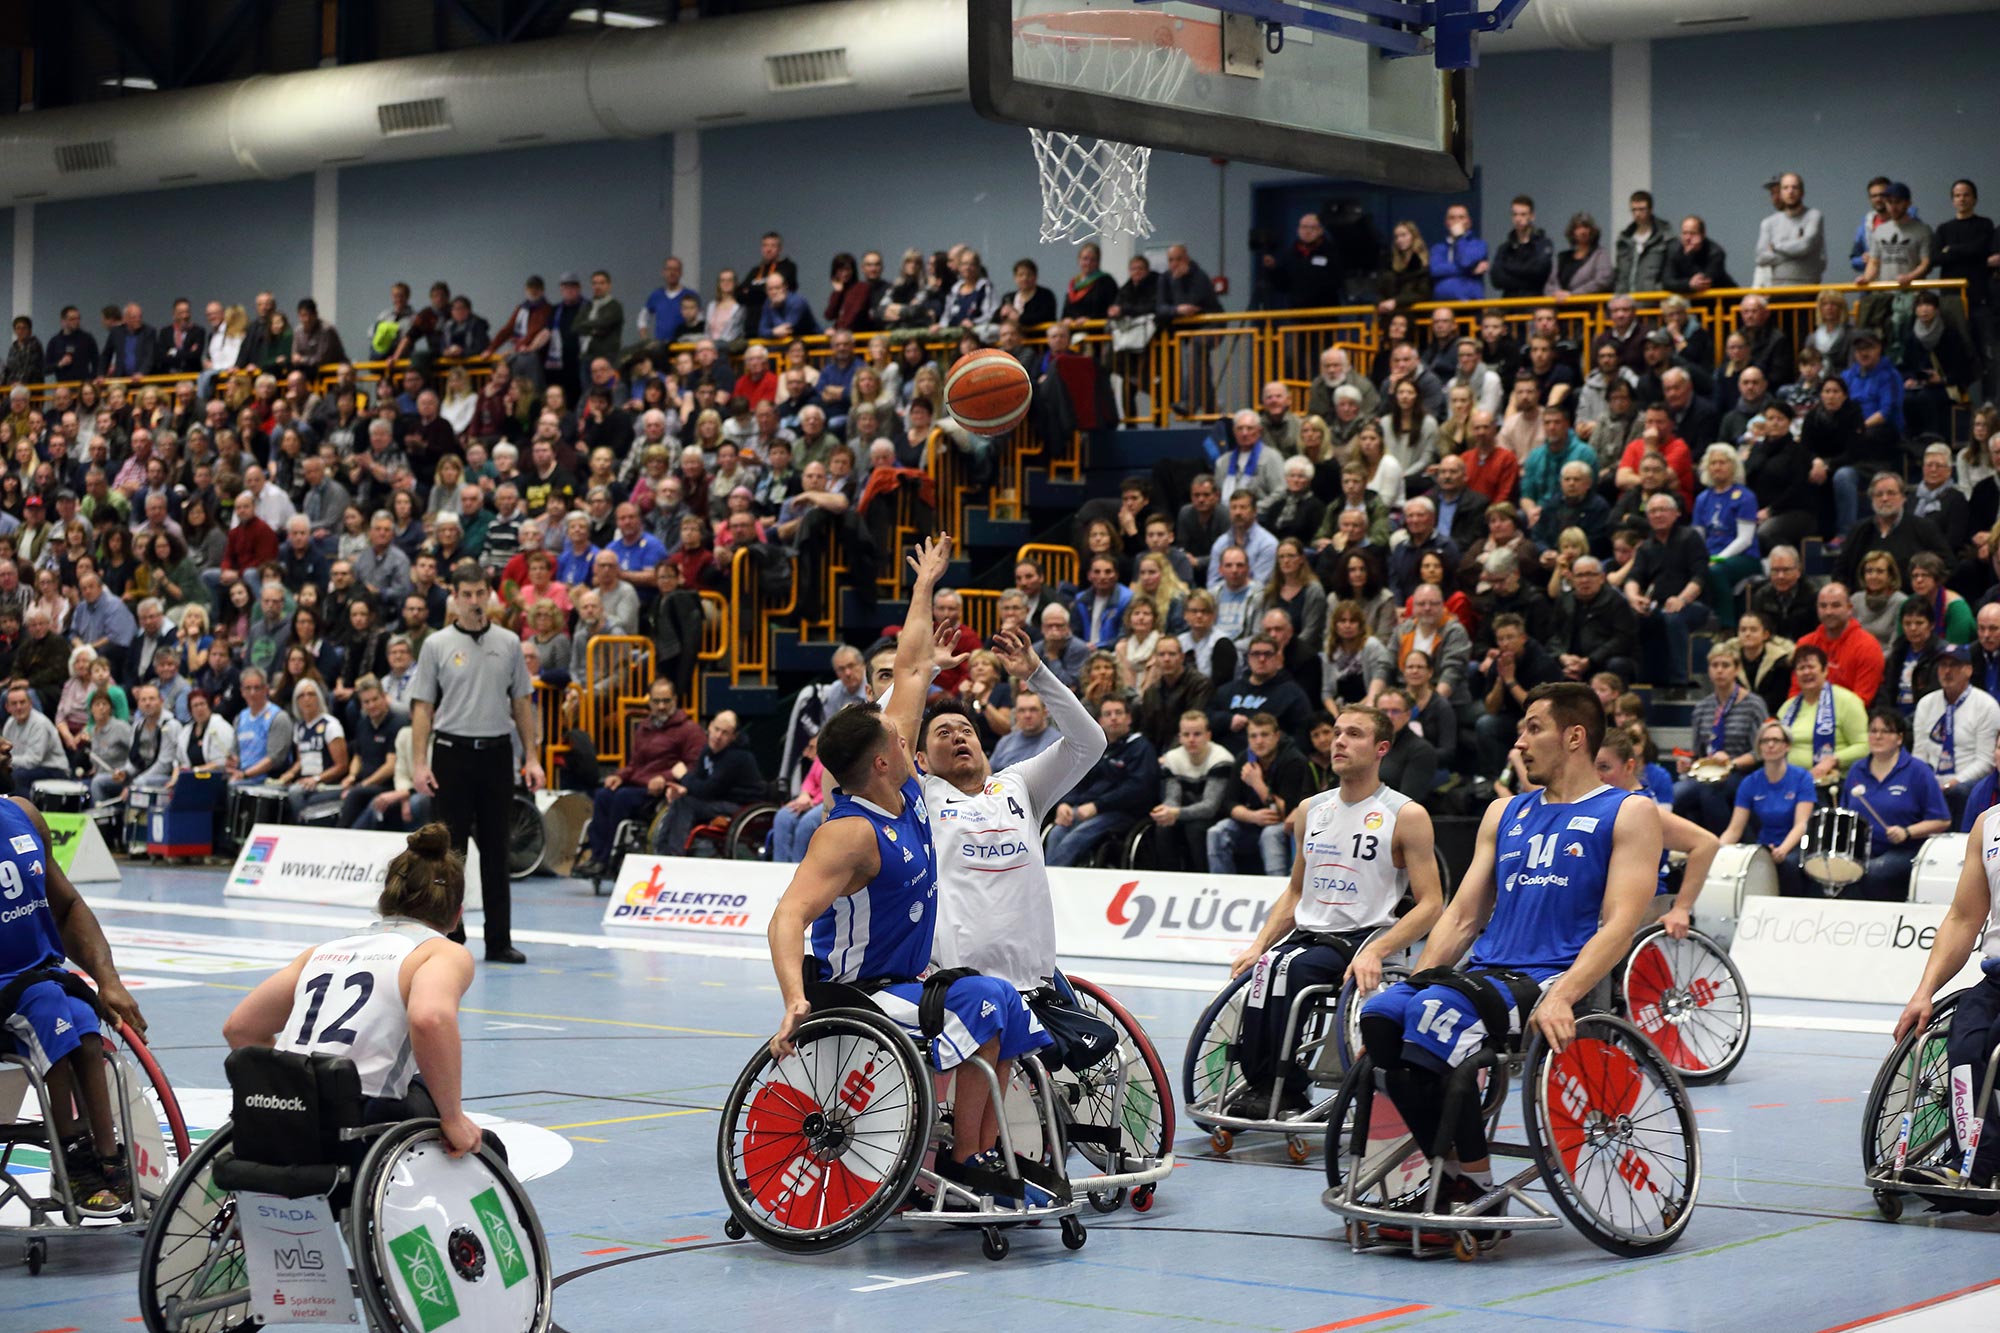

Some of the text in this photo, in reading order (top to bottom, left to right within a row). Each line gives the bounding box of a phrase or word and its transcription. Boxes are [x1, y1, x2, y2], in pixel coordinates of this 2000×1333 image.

[1007, 796, 1025, 820] 4
[961, 841, 1029, 858] STADA
[1352, 833, 1379, 861] 13
[1526, 832, 1560, 869] 14
[657, 891, 748, 907] ELEKTRO
[1159, 888, 1275, 933] LÜCK
[613, 904, 750, 928] PIECHOCKI
[1252, 955, 1270, 999] Medica
[295, 971, 375, 1046] 12
[1416, 999, 1463, 1044] 14
[245, 1094, 307, 1112] ottobock.
[1953, 1077, 1968, 1140] Medica
[257, 1205, 318, 1221] STADA
[273, 1237, 324, 1271] MLS
[485, 1210, 520, 1270] AOK
[402, 1245, 445, 1306] AOK
[290, 1296, 336, 1307] Sparkasse
[291, 1307, 328, 1318] Wetzlar
